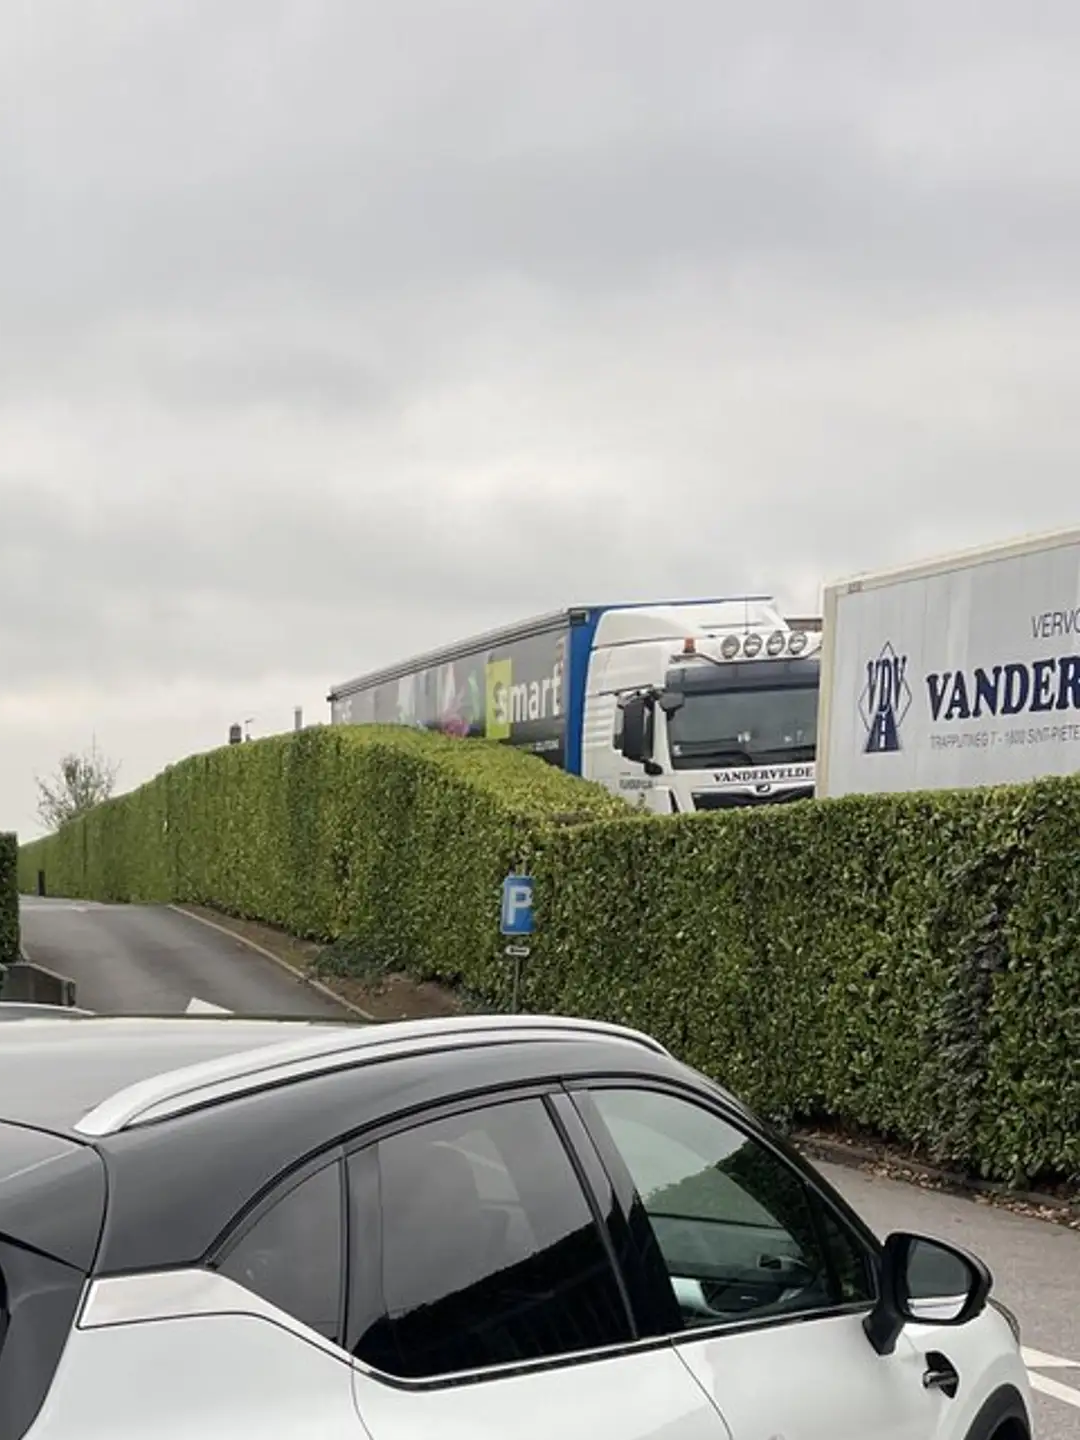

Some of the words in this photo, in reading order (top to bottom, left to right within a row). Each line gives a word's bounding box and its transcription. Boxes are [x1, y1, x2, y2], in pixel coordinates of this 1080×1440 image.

[926, 655, 1080, 721] VANDER
[713, 766, 814, 783] VANDERVELDE
[506, 885, 533, 926] P
